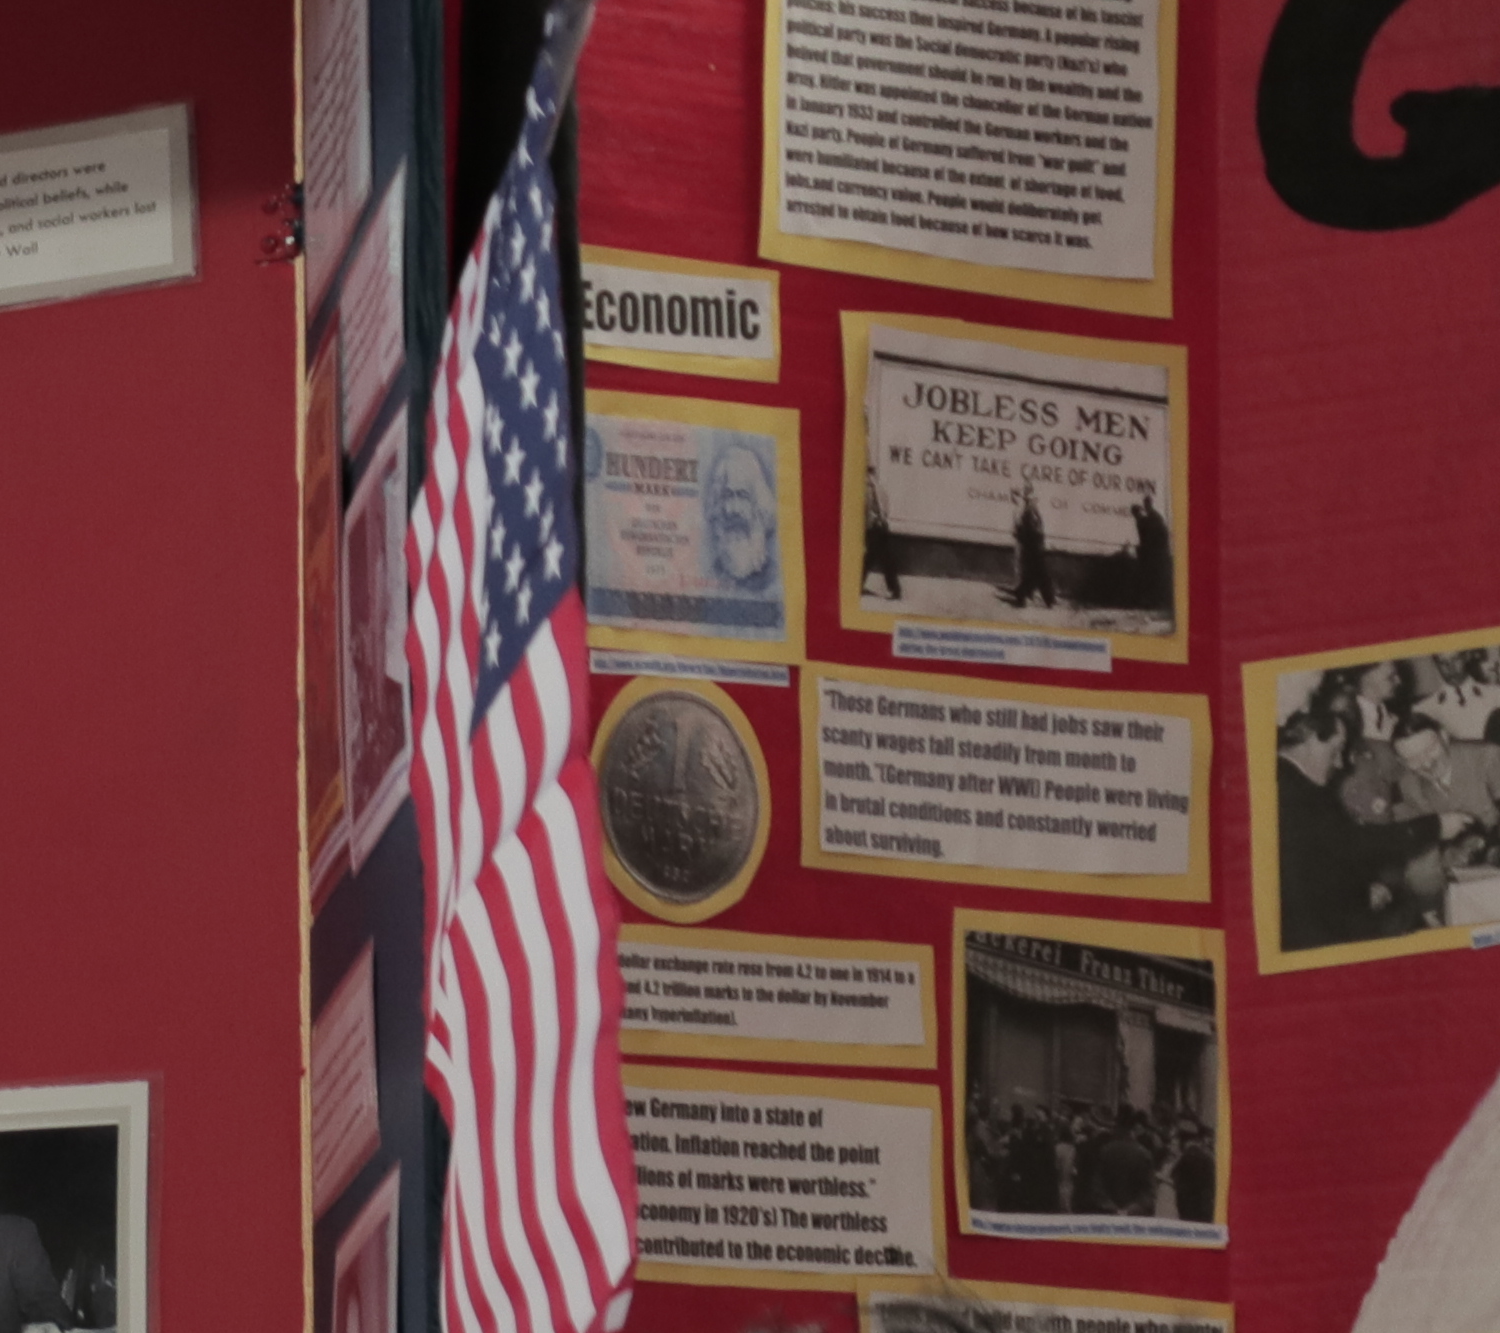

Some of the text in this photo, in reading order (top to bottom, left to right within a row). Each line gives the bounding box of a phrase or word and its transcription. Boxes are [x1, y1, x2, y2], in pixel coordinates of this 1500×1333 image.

[582, 280, 760, 340] Economic
[902, 384, 1149, 439] JOBLESS MEN
[932, 420, 1122, 465] KEEP GOING
[606, 452, 699, 483] HUNDERT
[889, 446, 912, 466] WE
[971, 455, 1011, 478] TAKE
[1019, 463, 1062, 483] CARE
[1067, 468, 1088, 486] OF
[1092, 471, 1120, 490] OUR
[1126, 477, 1156, 496] OWN
[877, 695, 945, 721] Germans
[949, 704, 982, 725] who
[986, 709, 1017, 728] still
[1021, 709, 1048, 731] had
[1051, 713, 1088, 735] jobs
[1091, 719, 1123, 737] saw
[1127, 720, 1164, 741] their
[821, 726, 1136, 773] scanty wages fall steadily from month to
[825, 789, 1157, 842] in brutal conditions and constantly worried
[958, 773, 995, 793] after
[1043, 779, 1100, 803] People
[1104, 788, 1143, 808] were
[1146, 788, 1188, 814] living
[824, 824, 945, 858] about surviving.
[1080, 948, 1132, 985] Franz
[1138, 967, 1185, 1000] Thier
[649, 1097, 823, 1127] Germany into a state of
